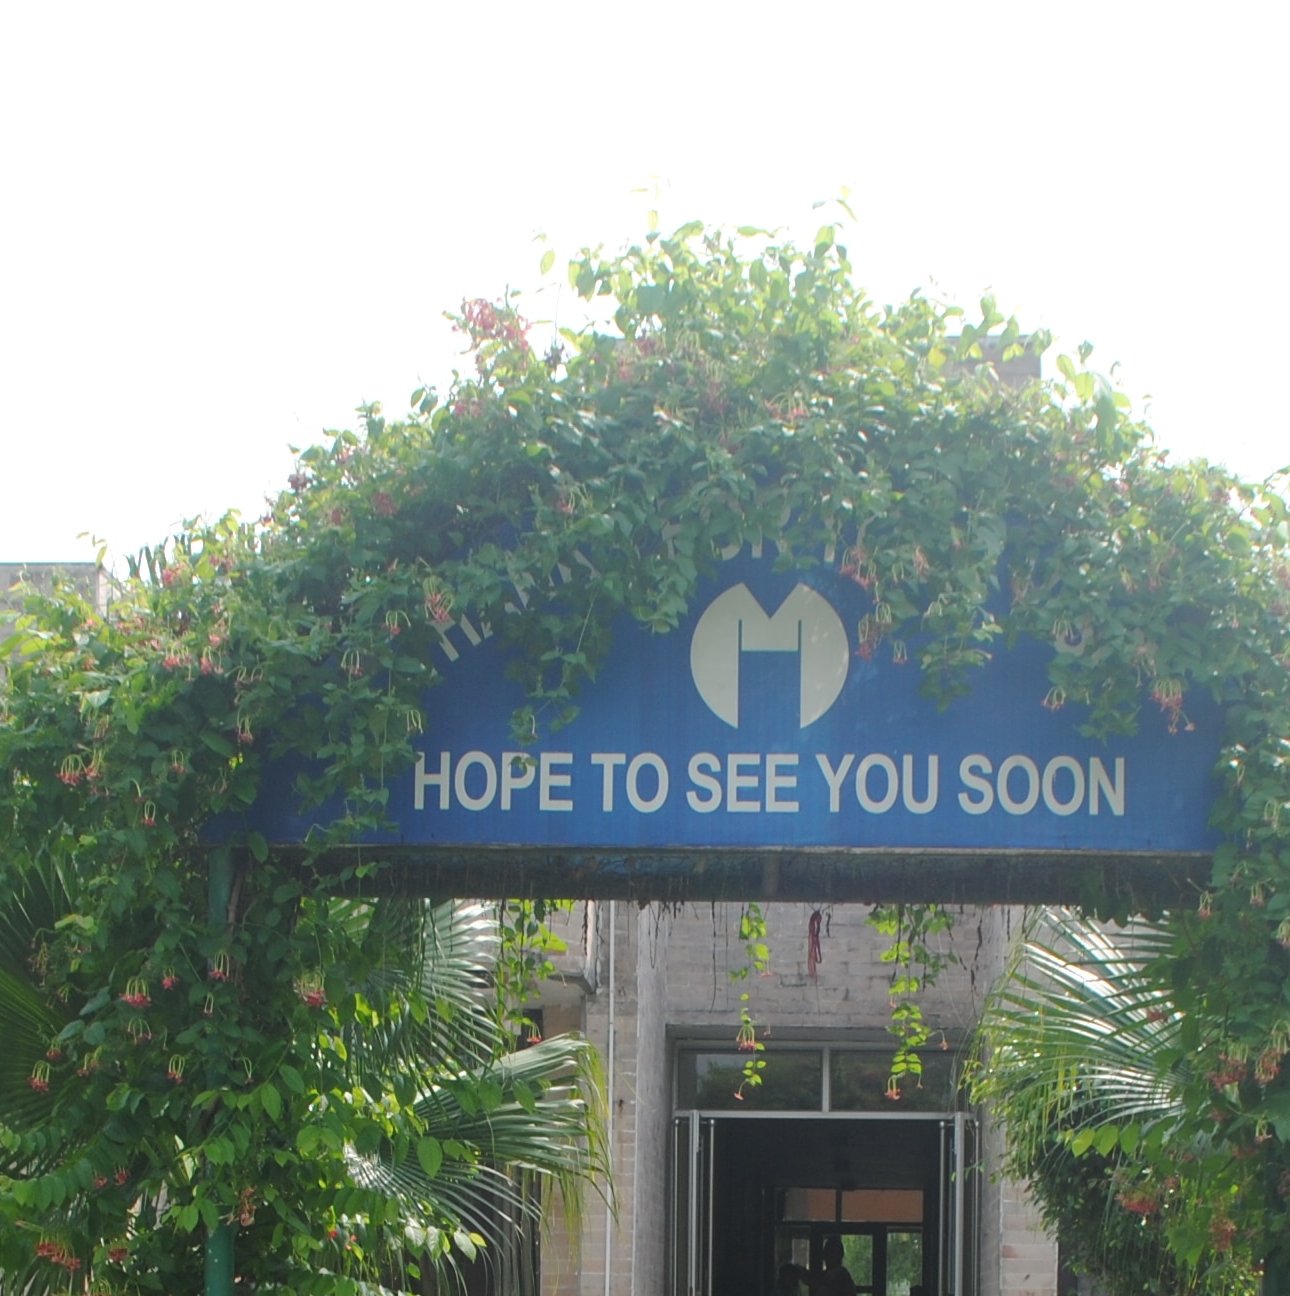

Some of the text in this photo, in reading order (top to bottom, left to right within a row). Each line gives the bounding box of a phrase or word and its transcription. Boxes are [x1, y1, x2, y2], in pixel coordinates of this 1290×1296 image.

[414, 750, 1125, 816] HOPE TO SEE YOU SOON
